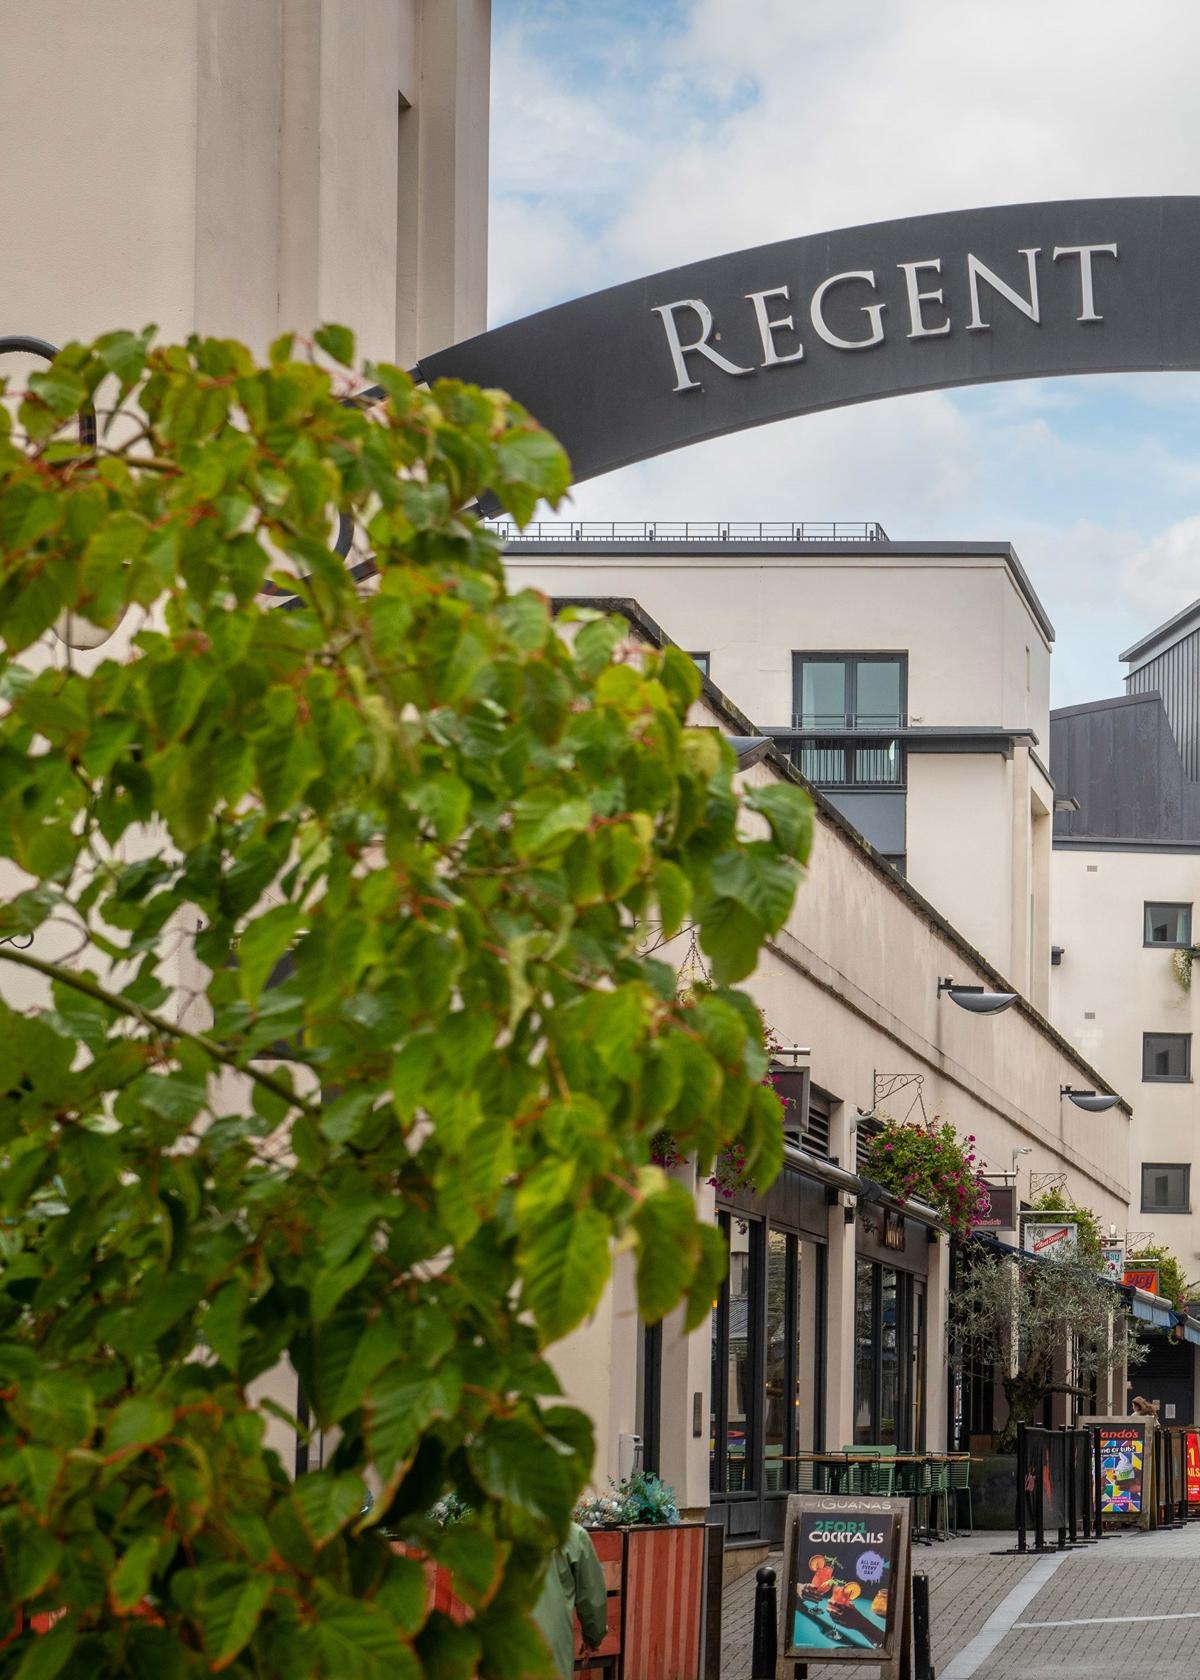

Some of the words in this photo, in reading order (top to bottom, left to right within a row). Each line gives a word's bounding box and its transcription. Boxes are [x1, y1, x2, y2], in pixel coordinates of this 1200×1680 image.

[651, 243, 1118, 393] REGENT
[1100, 1428, 1139, 1438] ando's
[809, 1531, 884, 1544] COCKTAILS
